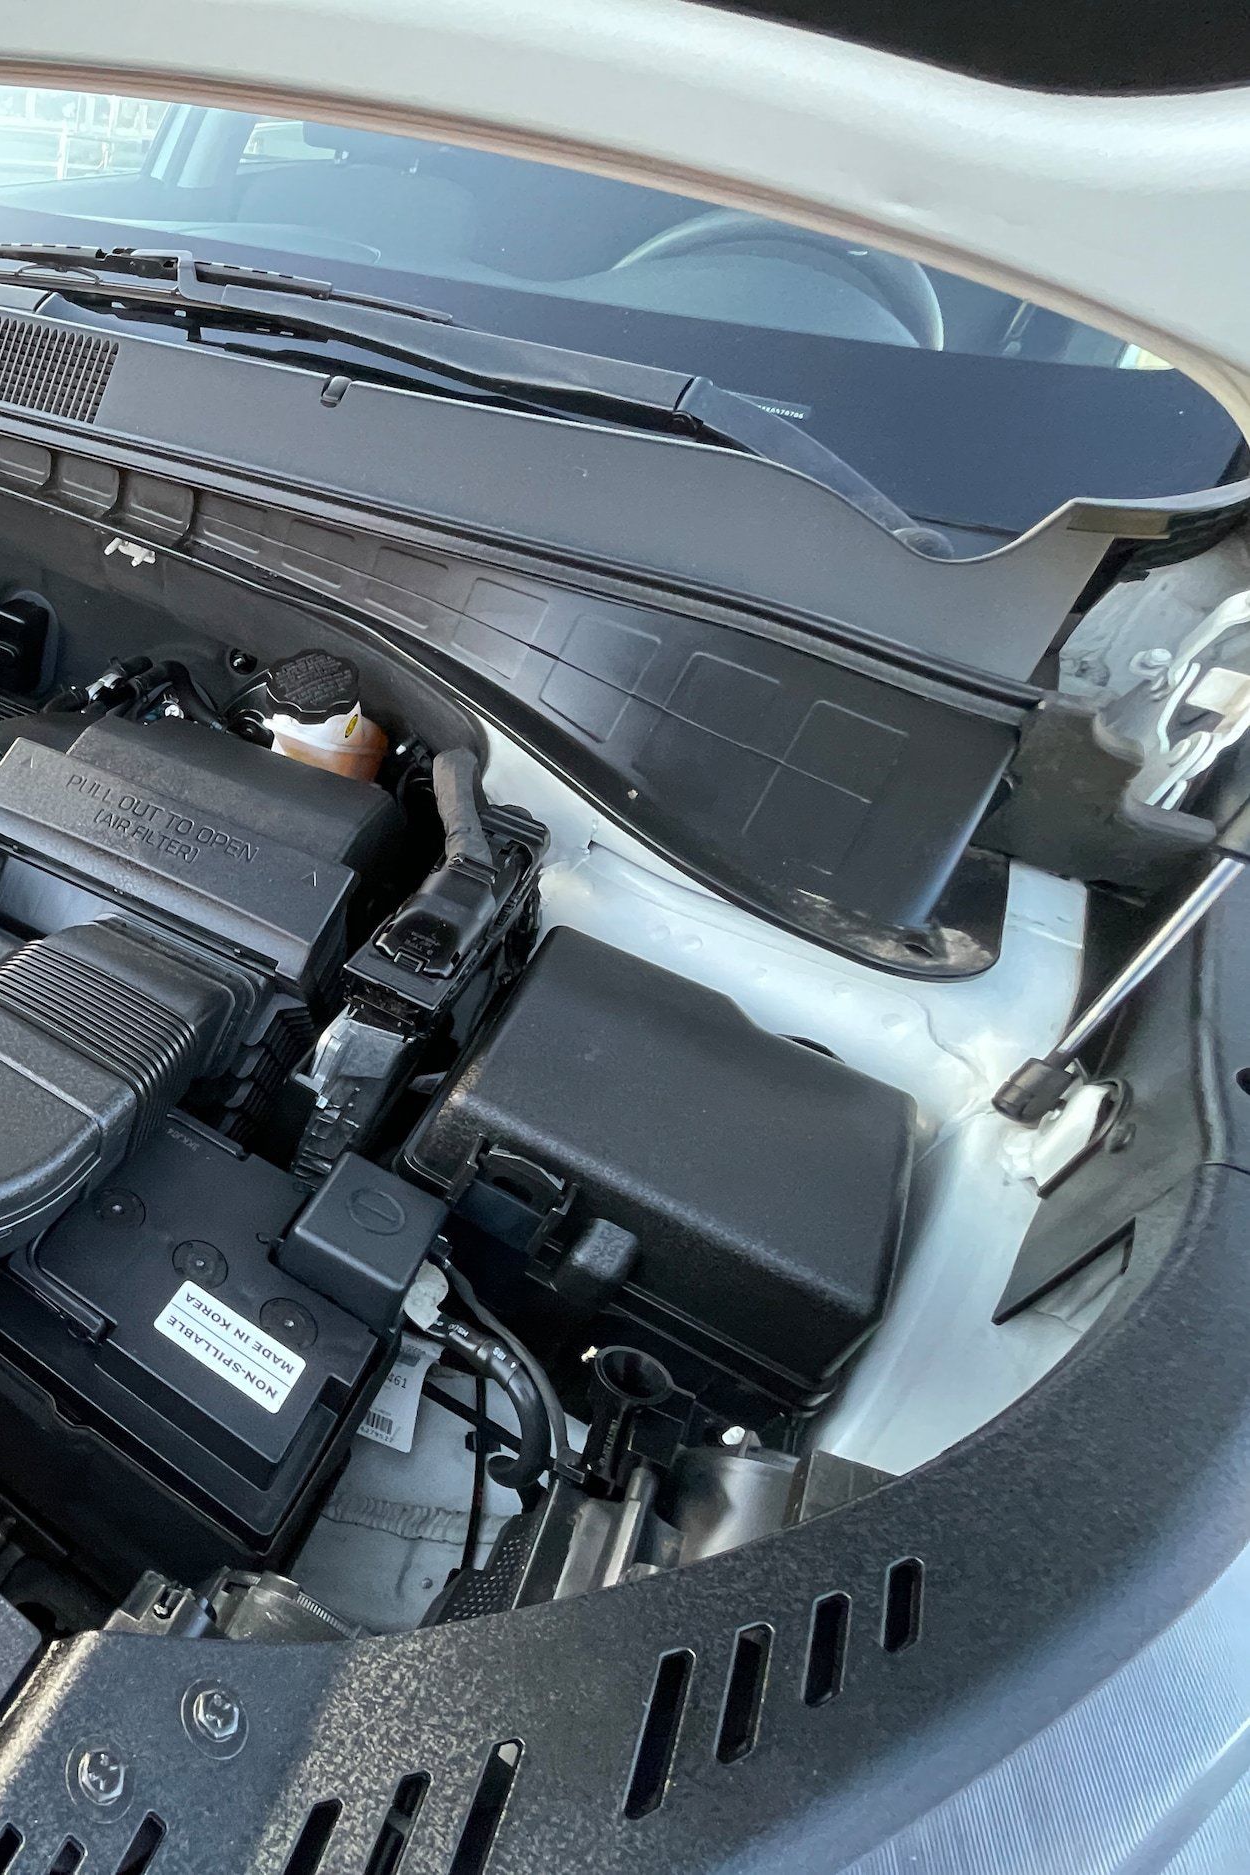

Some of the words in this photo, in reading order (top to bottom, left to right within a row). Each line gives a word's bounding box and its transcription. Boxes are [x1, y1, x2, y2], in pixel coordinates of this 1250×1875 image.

[66, 774, 111, 804] PULL
[118, 794, 165, 822] OUT
[164, 811, 195, 835] TO
[197, 825, 259, 862] OPEN
[185, 1292, 232, 1331] KOREA
[233, 1327, 251, 1344] IN
[166, 1315, 279, 1400] NON-SPILLABLE
[251, 1340, 295, 1375] MADE
